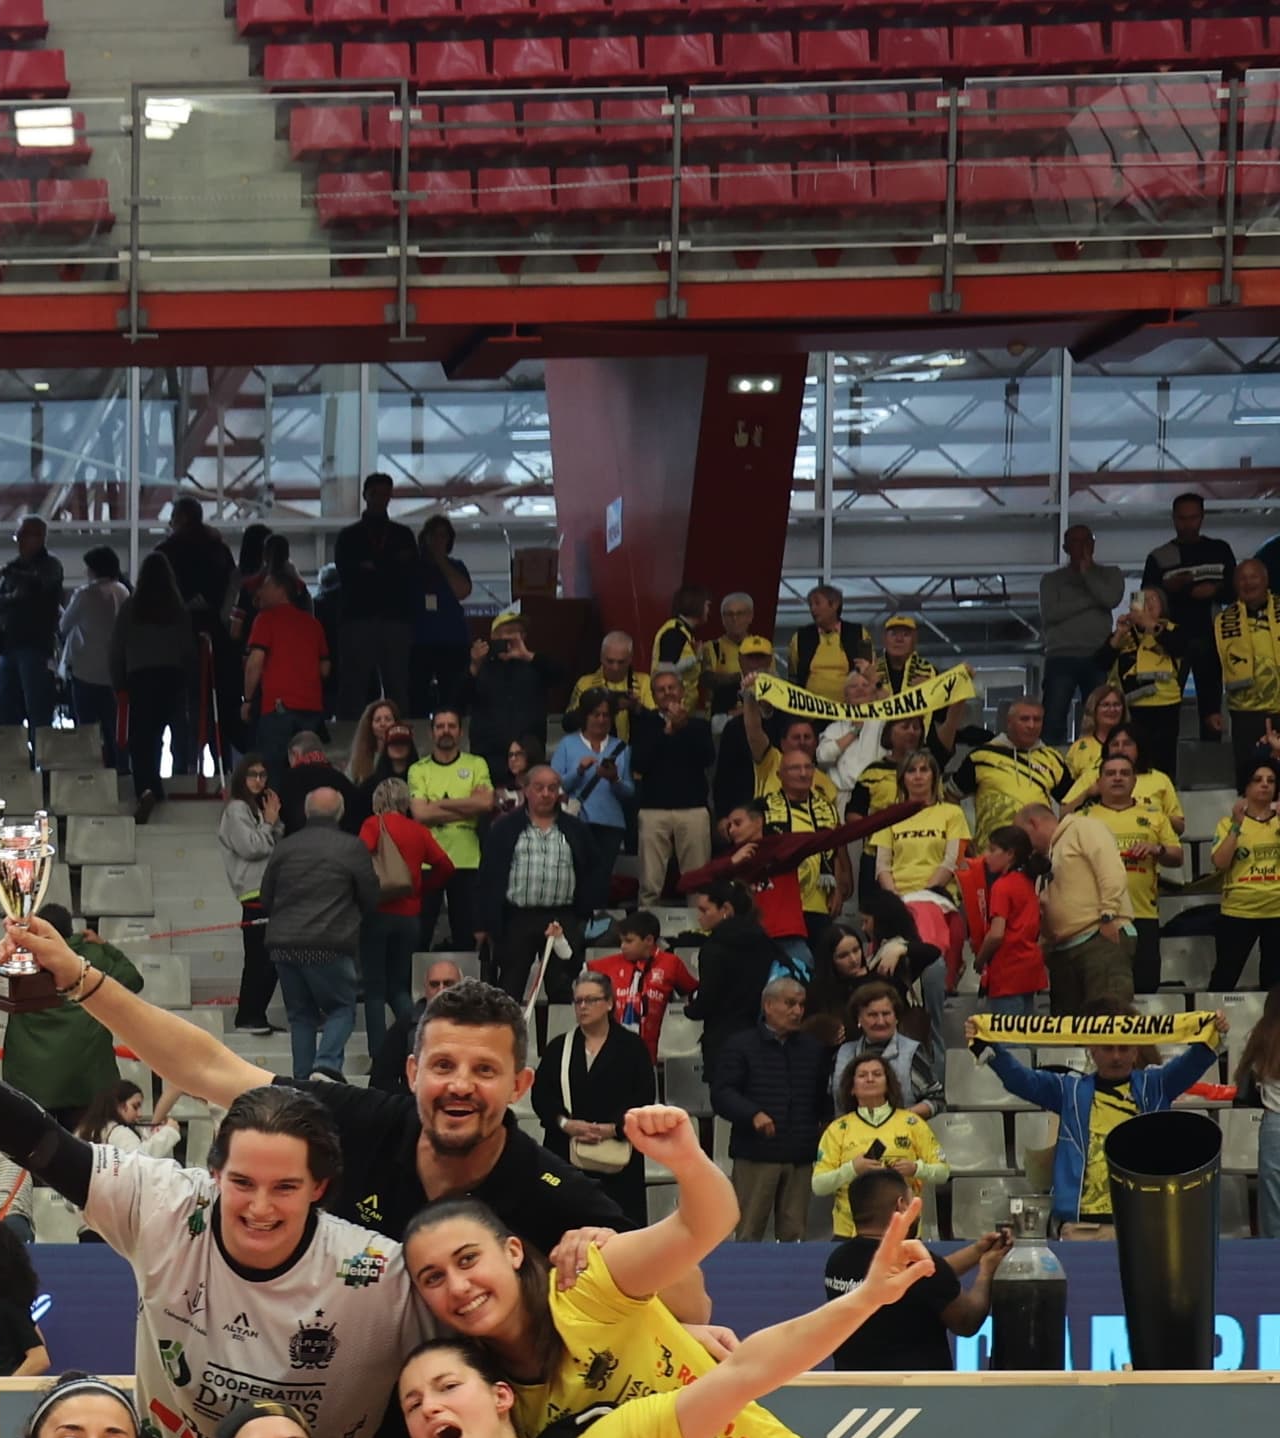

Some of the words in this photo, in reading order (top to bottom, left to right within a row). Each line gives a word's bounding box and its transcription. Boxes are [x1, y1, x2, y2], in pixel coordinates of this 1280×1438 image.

[787, 687, 840, 718] HOQUEI
[842, 688, 929, 719] VILA-SANA
[1070, 1013, 1175, 1035] VILA-SANA
[342, 1262, 378, 1277] lleida
[360, 1255, 383, 1267] ara
[222, 1324, 259, 1339] ALTAN
[202, 1369, 324, 1403] COOPERATIVA
